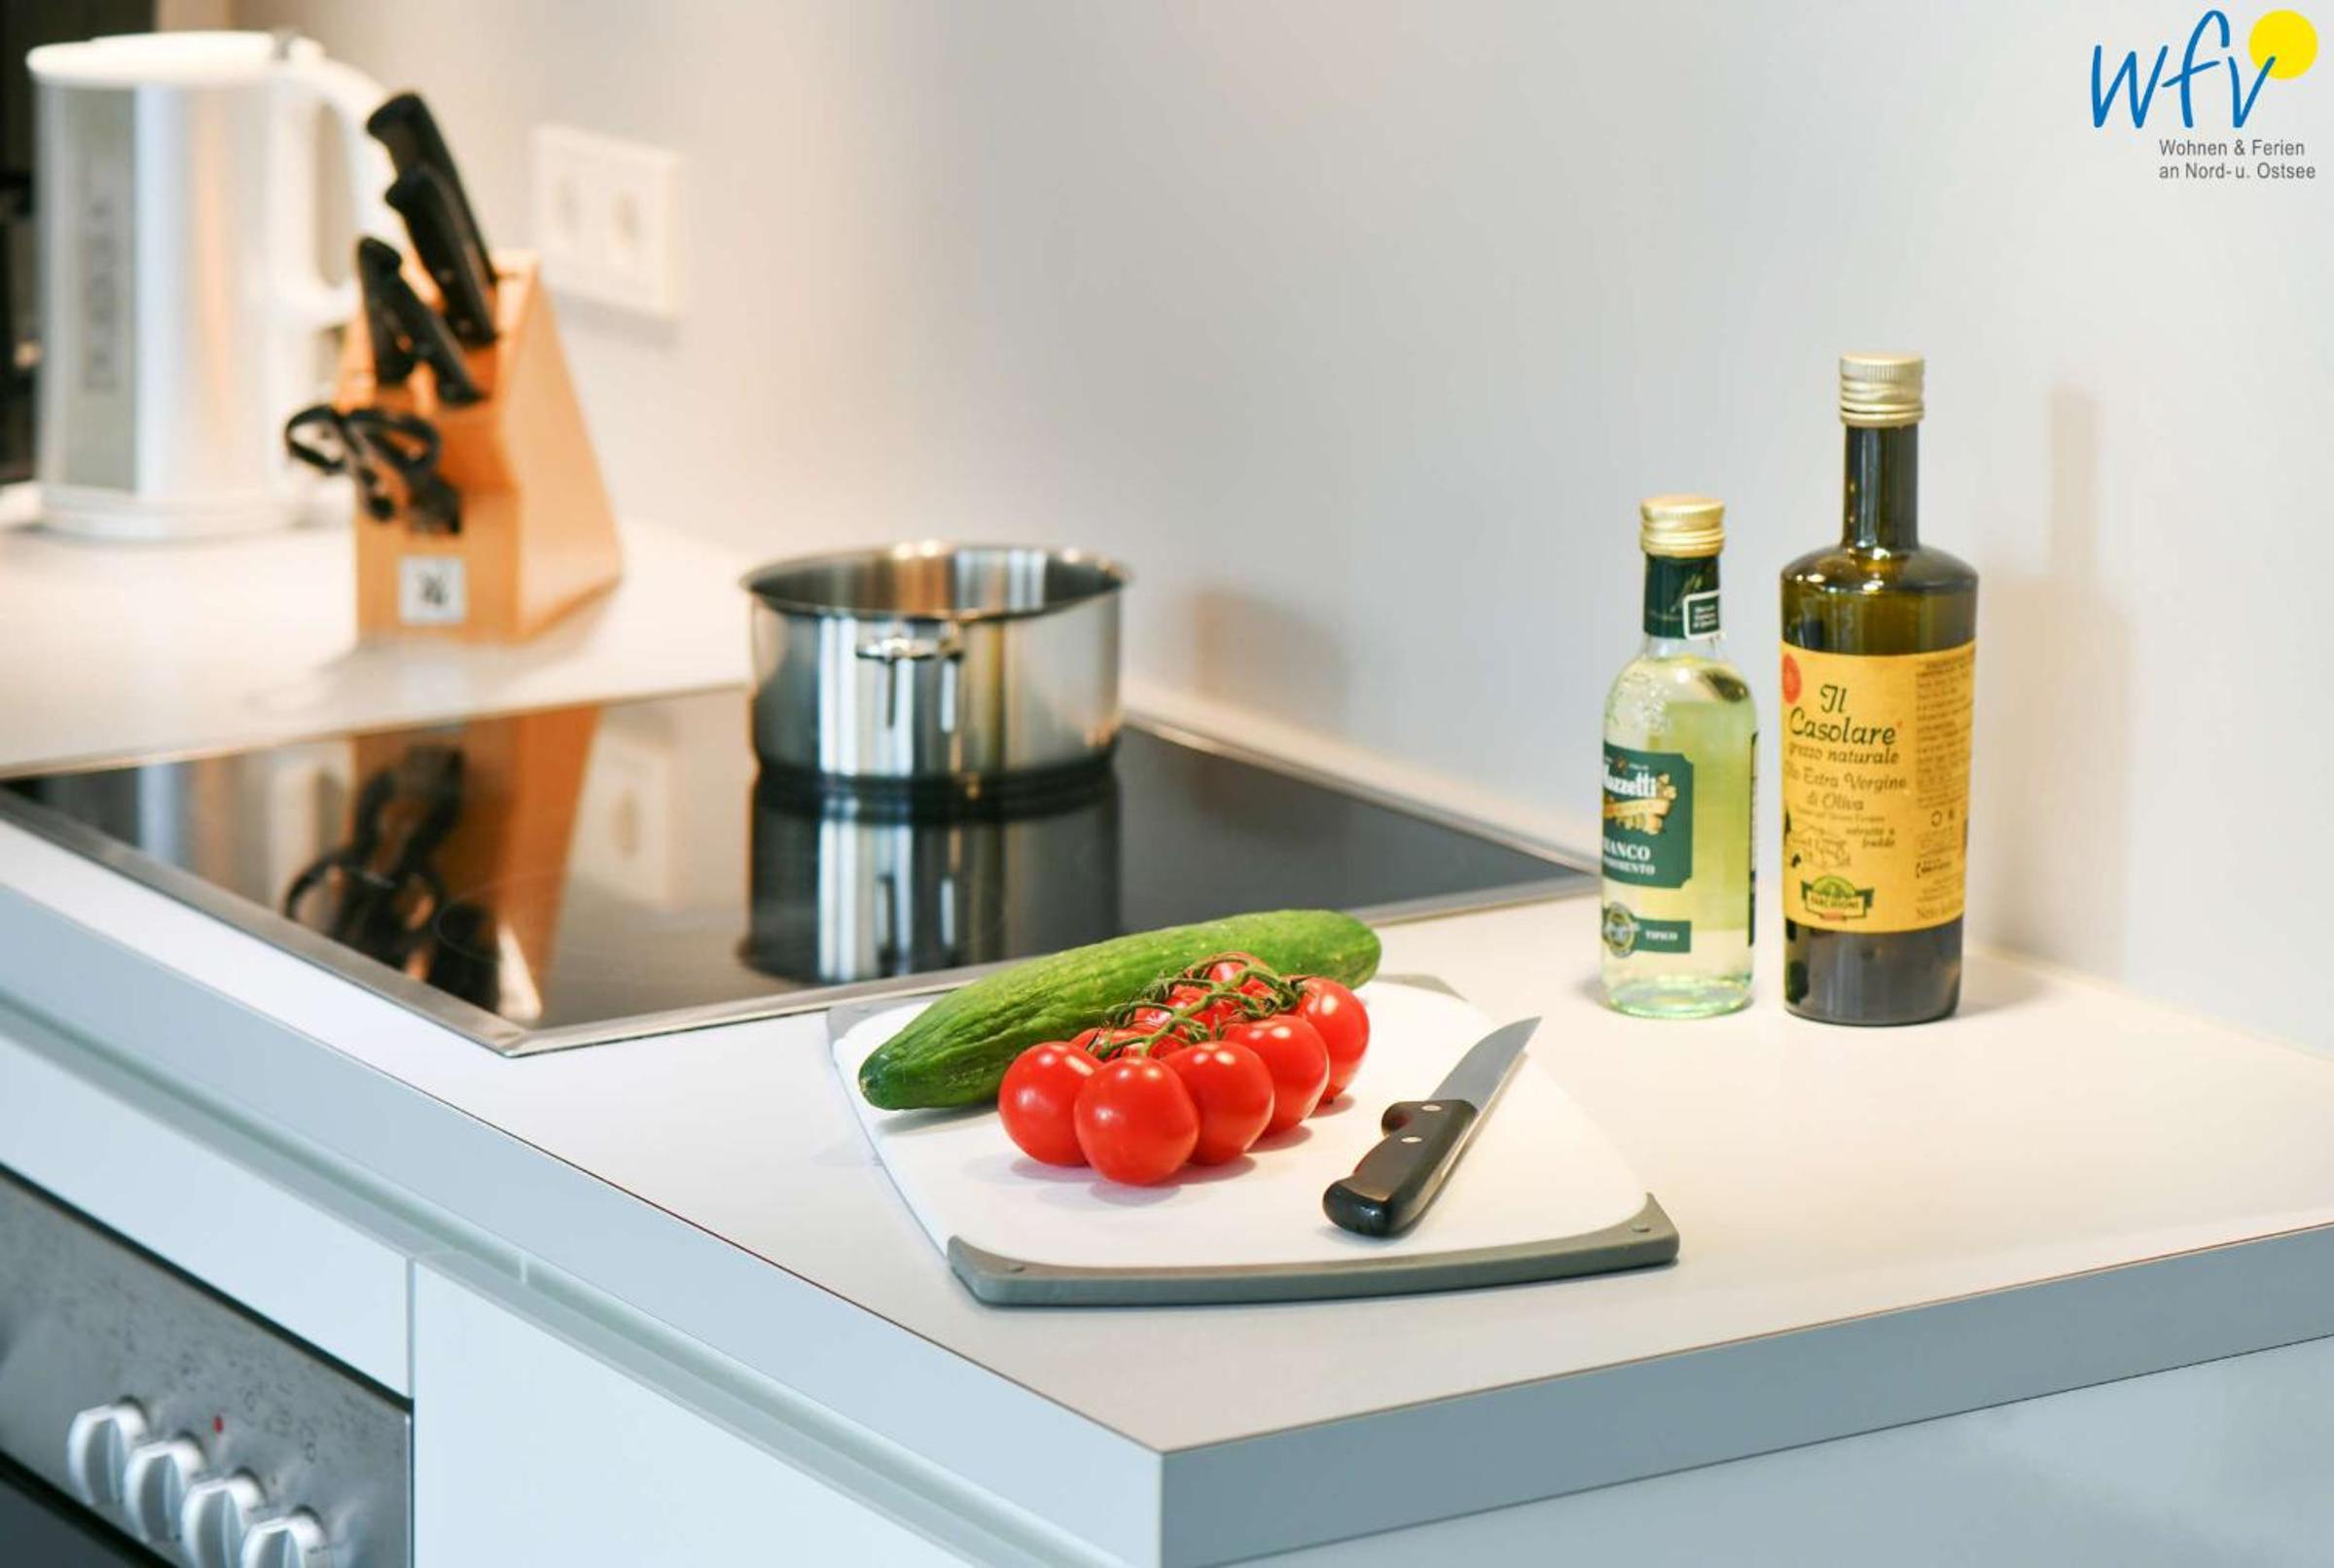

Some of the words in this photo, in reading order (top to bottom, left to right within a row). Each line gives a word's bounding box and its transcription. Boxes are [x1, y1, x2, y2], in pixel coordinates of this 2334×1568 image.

[1789, 707, 1897, 746] Casolare
[1828, 747, 1901, 765] naturale
[1844, 772, 1907, 794] Vergine
[1821, 793, 1865, 810] Oliva
